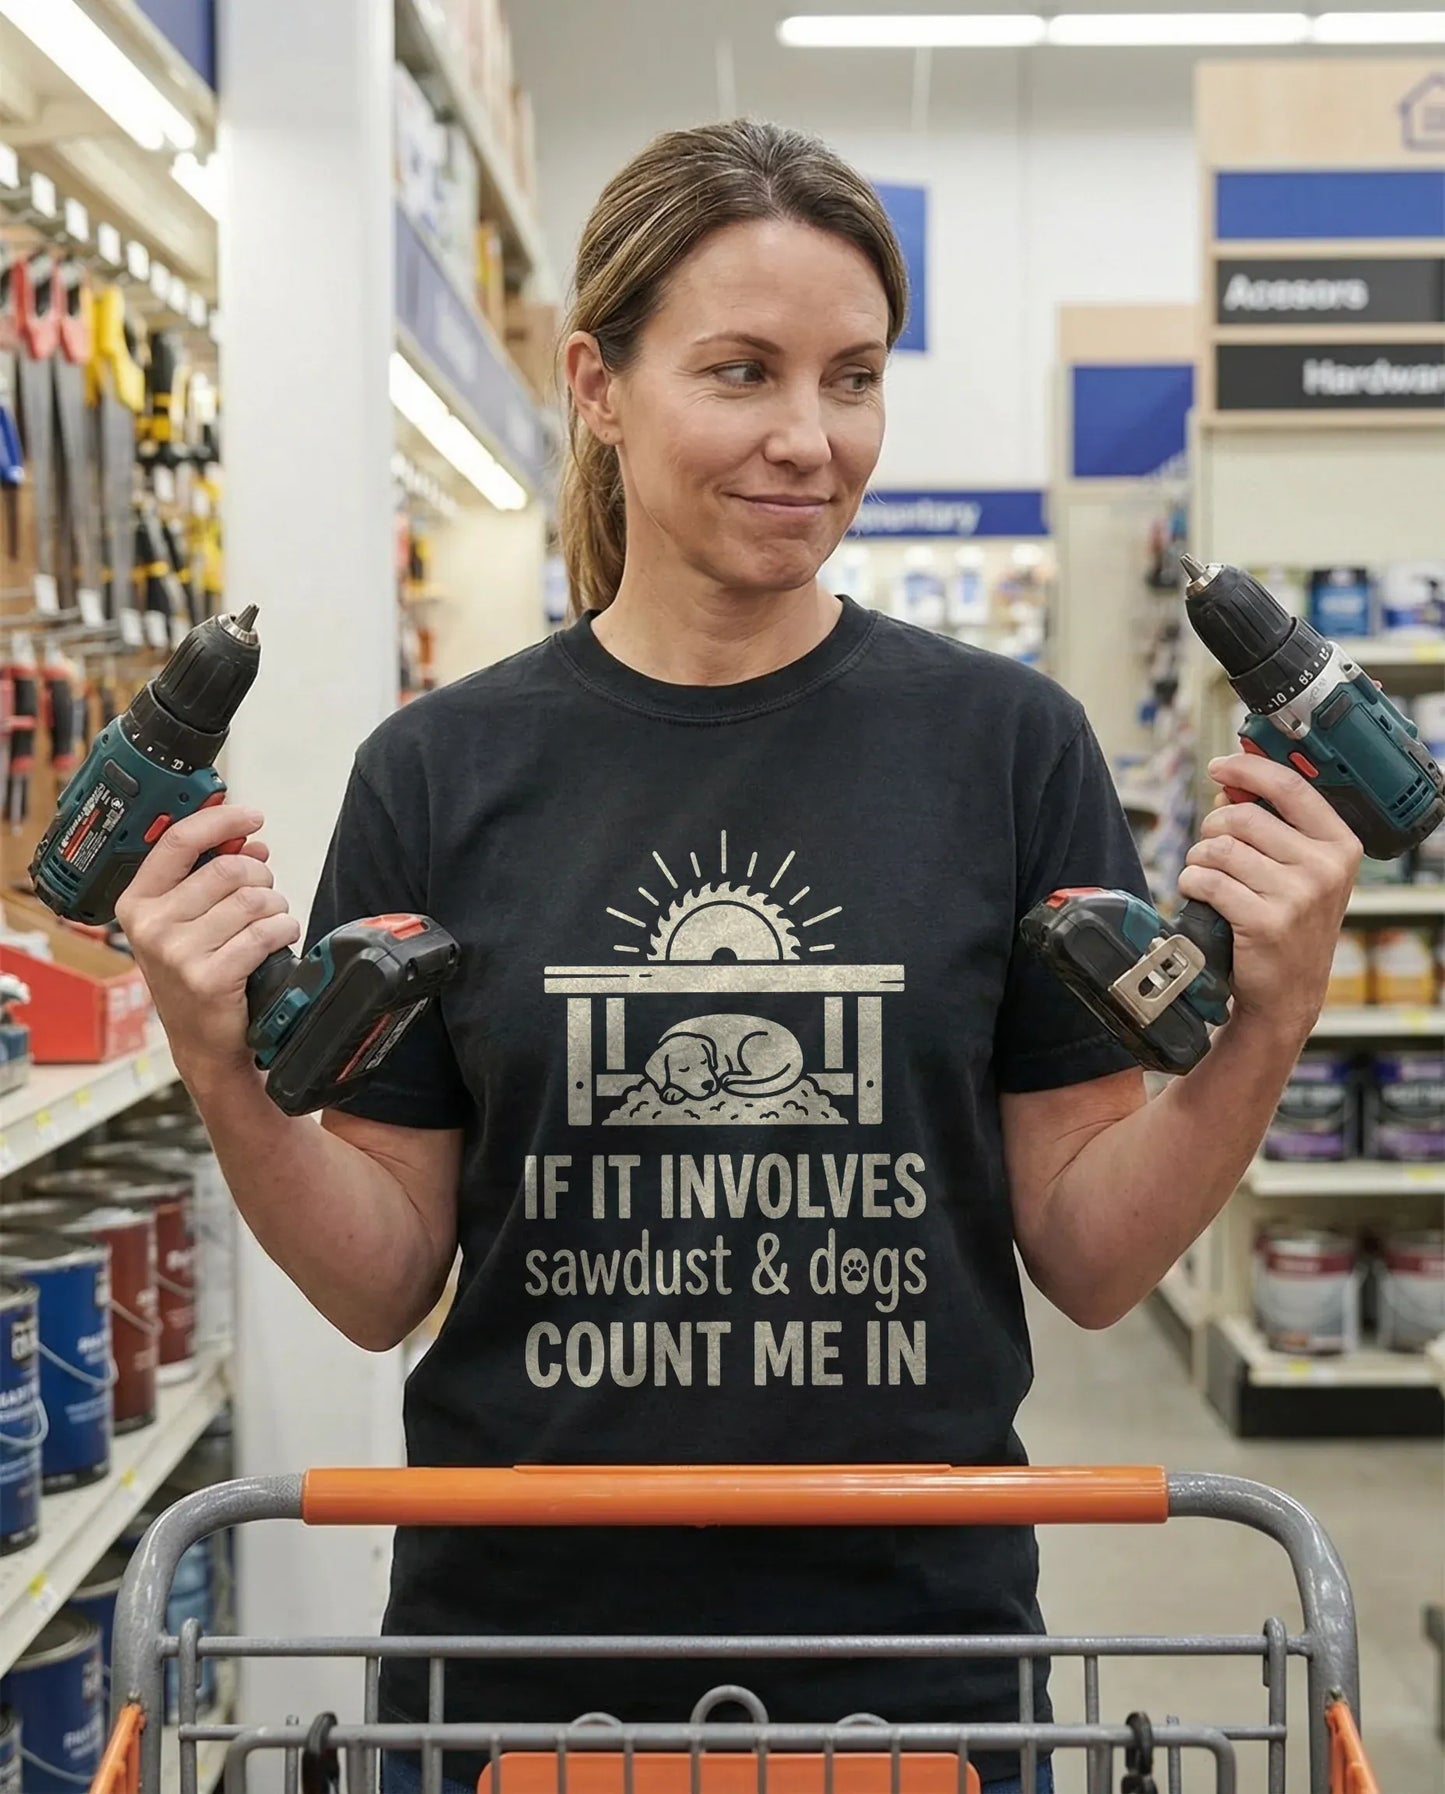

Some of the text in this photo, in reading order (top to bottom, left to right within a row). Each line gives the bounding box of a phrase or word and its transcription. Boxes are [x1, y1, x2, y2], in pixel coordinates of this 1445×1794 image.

[525, 1152, 927, 1219] IF IT INVOLVES
[525, 1228, 928, 1313] sawdust & dogs
[525, 1321, 927, 1388] COUNT ME IN
